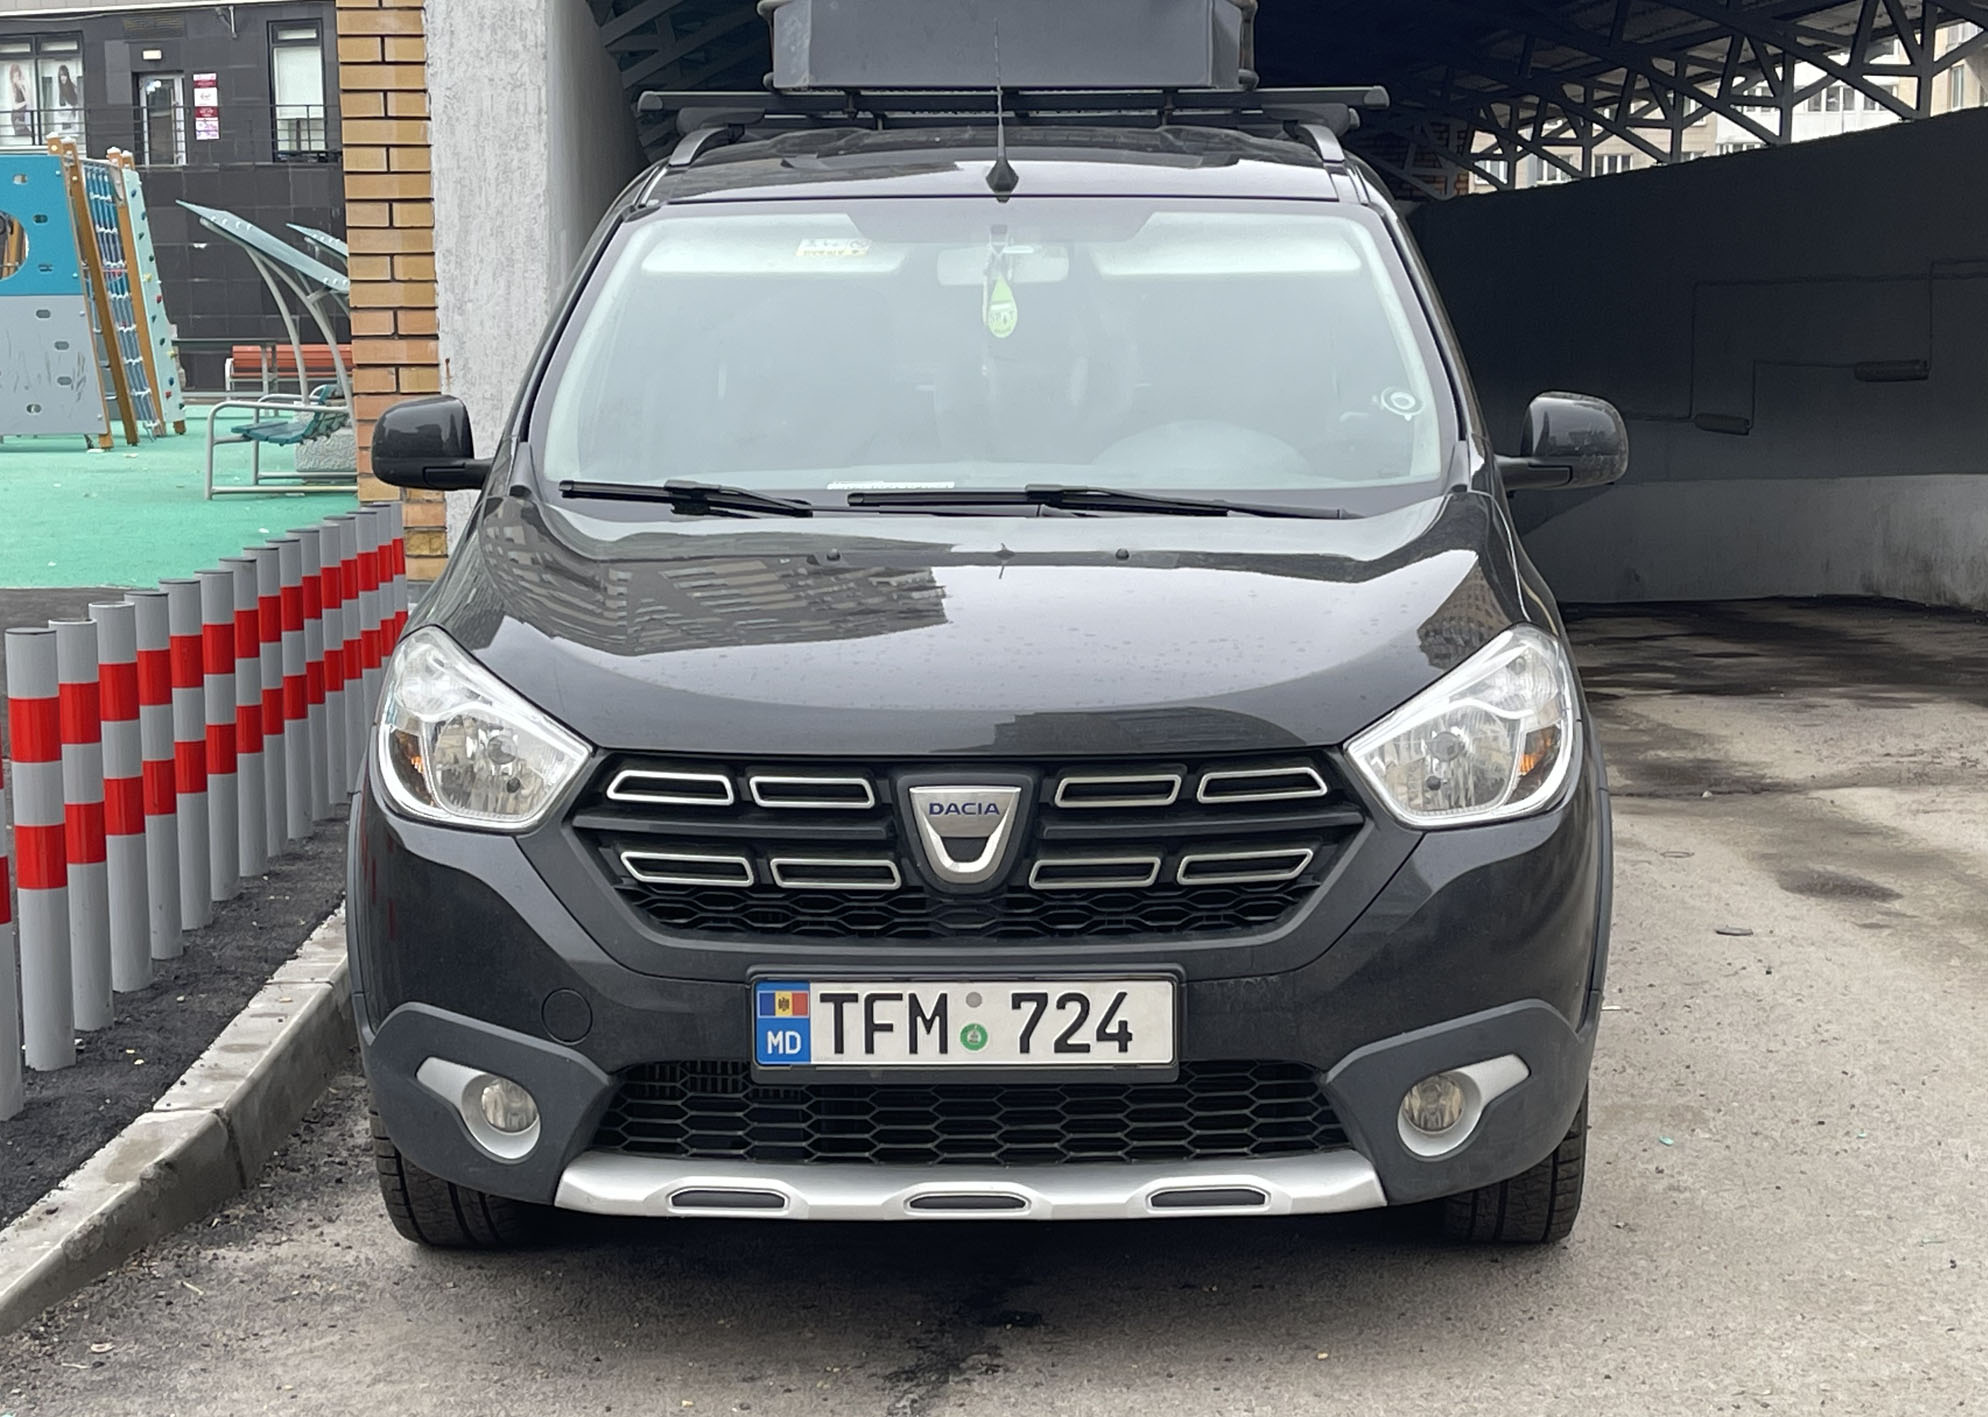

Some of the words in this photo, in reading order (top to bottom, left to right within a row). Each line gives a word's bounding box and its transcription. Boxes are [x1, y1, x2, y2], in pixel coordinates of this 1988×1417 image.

[928, 802, 1000, 815] DACIA
[819, 992, 949, 1055] TFM
[1011, 991, 1133, 1054] 724
[767, 1031, 801, 1055] MD
